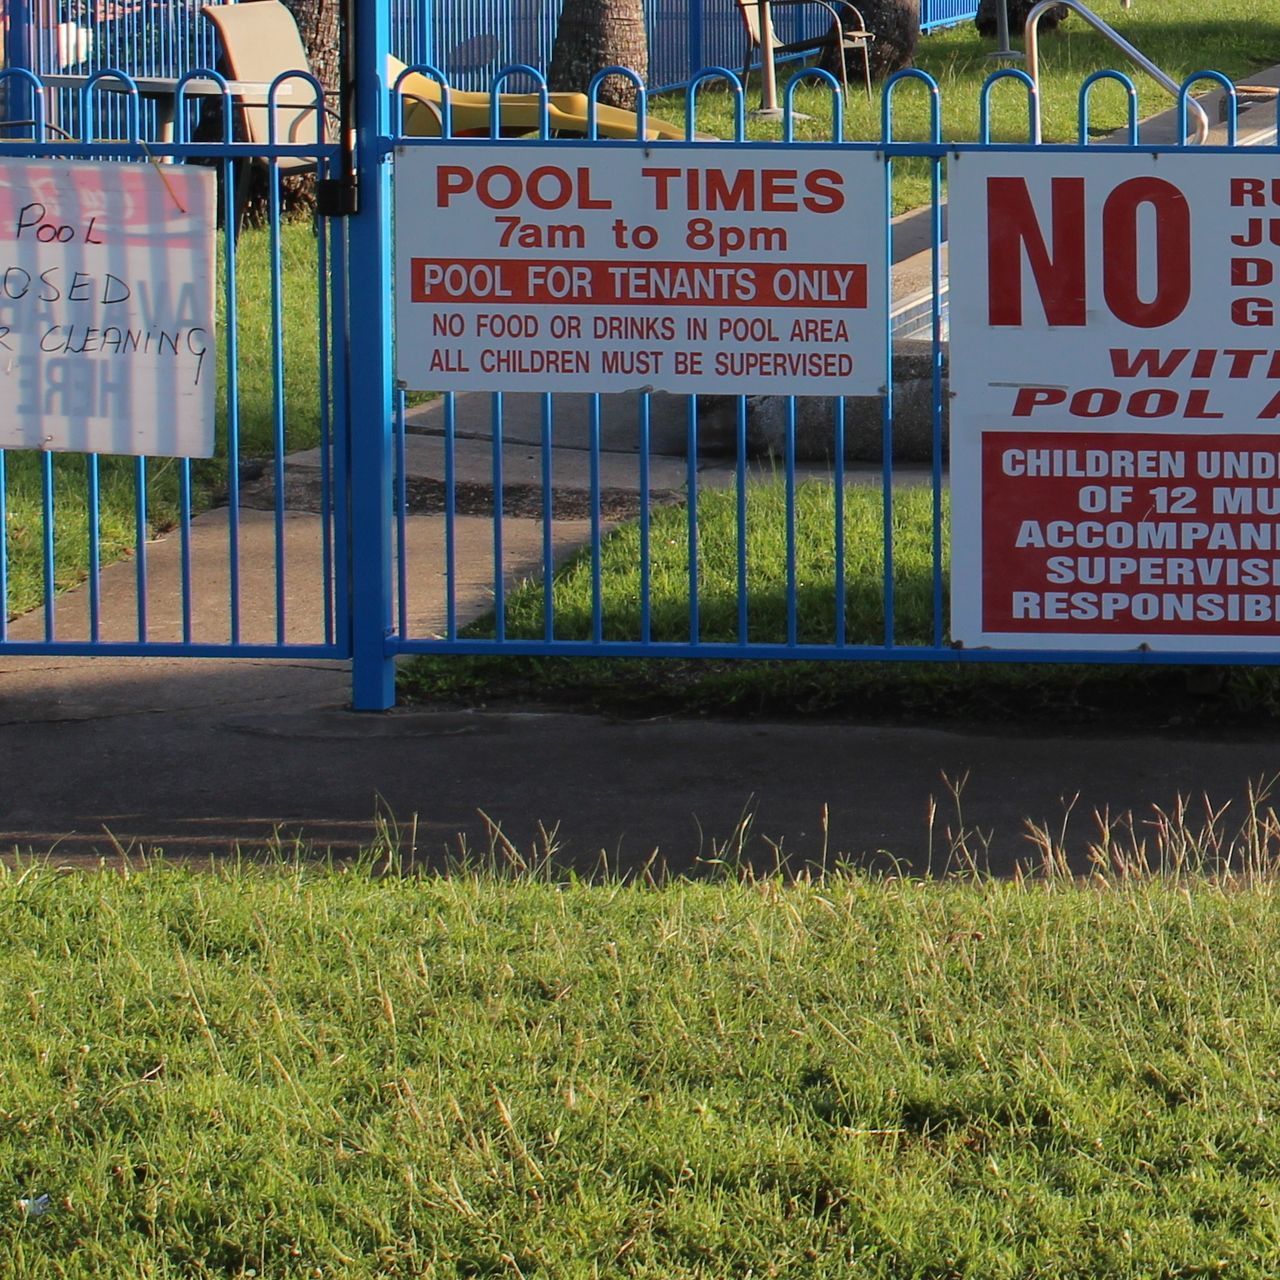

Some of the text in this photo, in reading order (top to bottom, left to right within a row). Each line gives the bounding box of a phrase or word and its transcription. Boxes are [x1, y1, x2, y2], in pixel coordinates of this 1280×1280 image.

[437, 165, 845, 214] POOL TIMES
[495, 216, 787, 257] 7am to 8pm
[986, 176, 1192, 329] NO
[0, 266, 131, 305] OSED
[424, 264, 854, 302] POOL FOR TENANTS ONLY
[433, 313, 849, 343] NO FOOD OR DRINKS IN POOL AREA
[430, 349, 853, 377] ALL CHILDREN MUST BE SUPERVISED
[1011, 388, 1224, 419] POOL
[1002, 449, 1184, 478] CHILDREN
[1078, 486, 1132, 514] OF
[1149, 486, 1196, 515] 12
